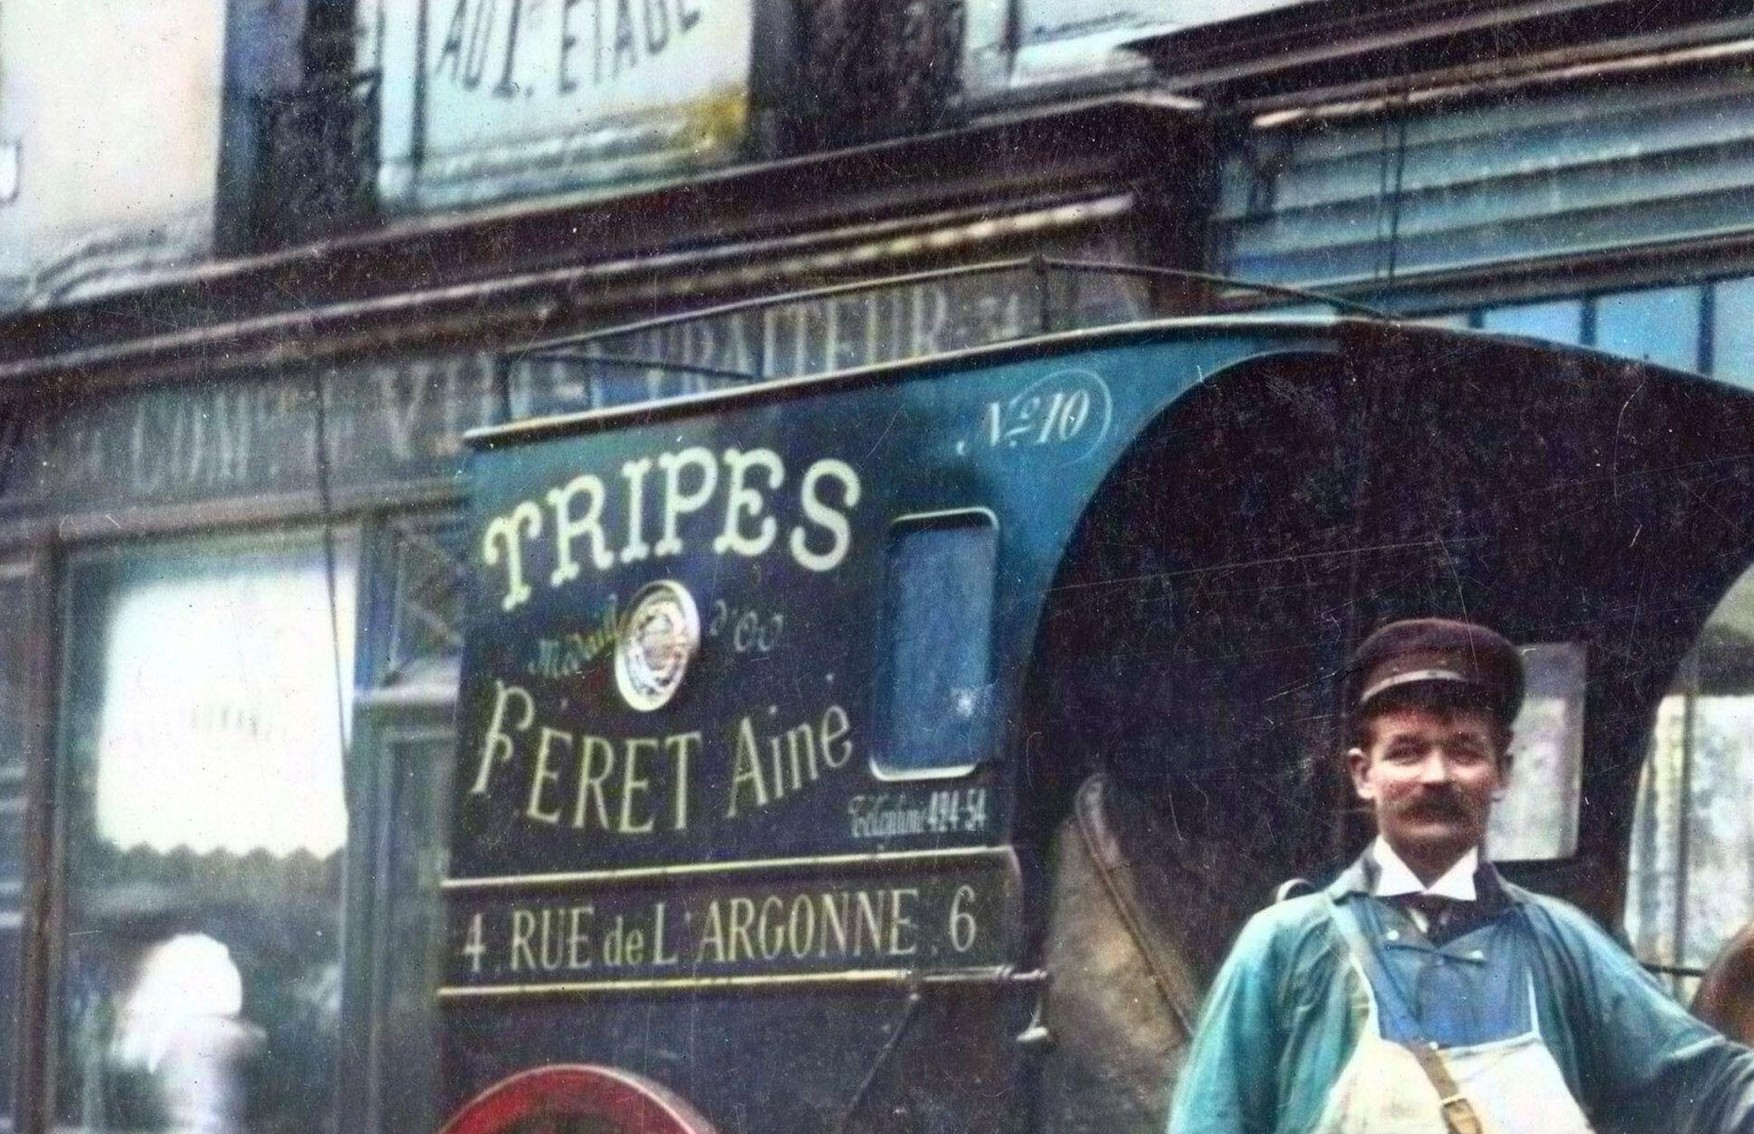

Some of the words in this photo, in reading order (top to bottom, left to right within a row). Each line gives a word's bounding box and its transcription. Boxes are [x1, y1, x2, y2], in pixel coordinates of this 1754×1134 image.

[1035, 388, 1091, 446] 10
[483, 446, 862, 612] TRIPES
[462, 912, 487, 973] 4
[510, 905, 595, 971] RUE
[950, 884, 977, 953] 6
